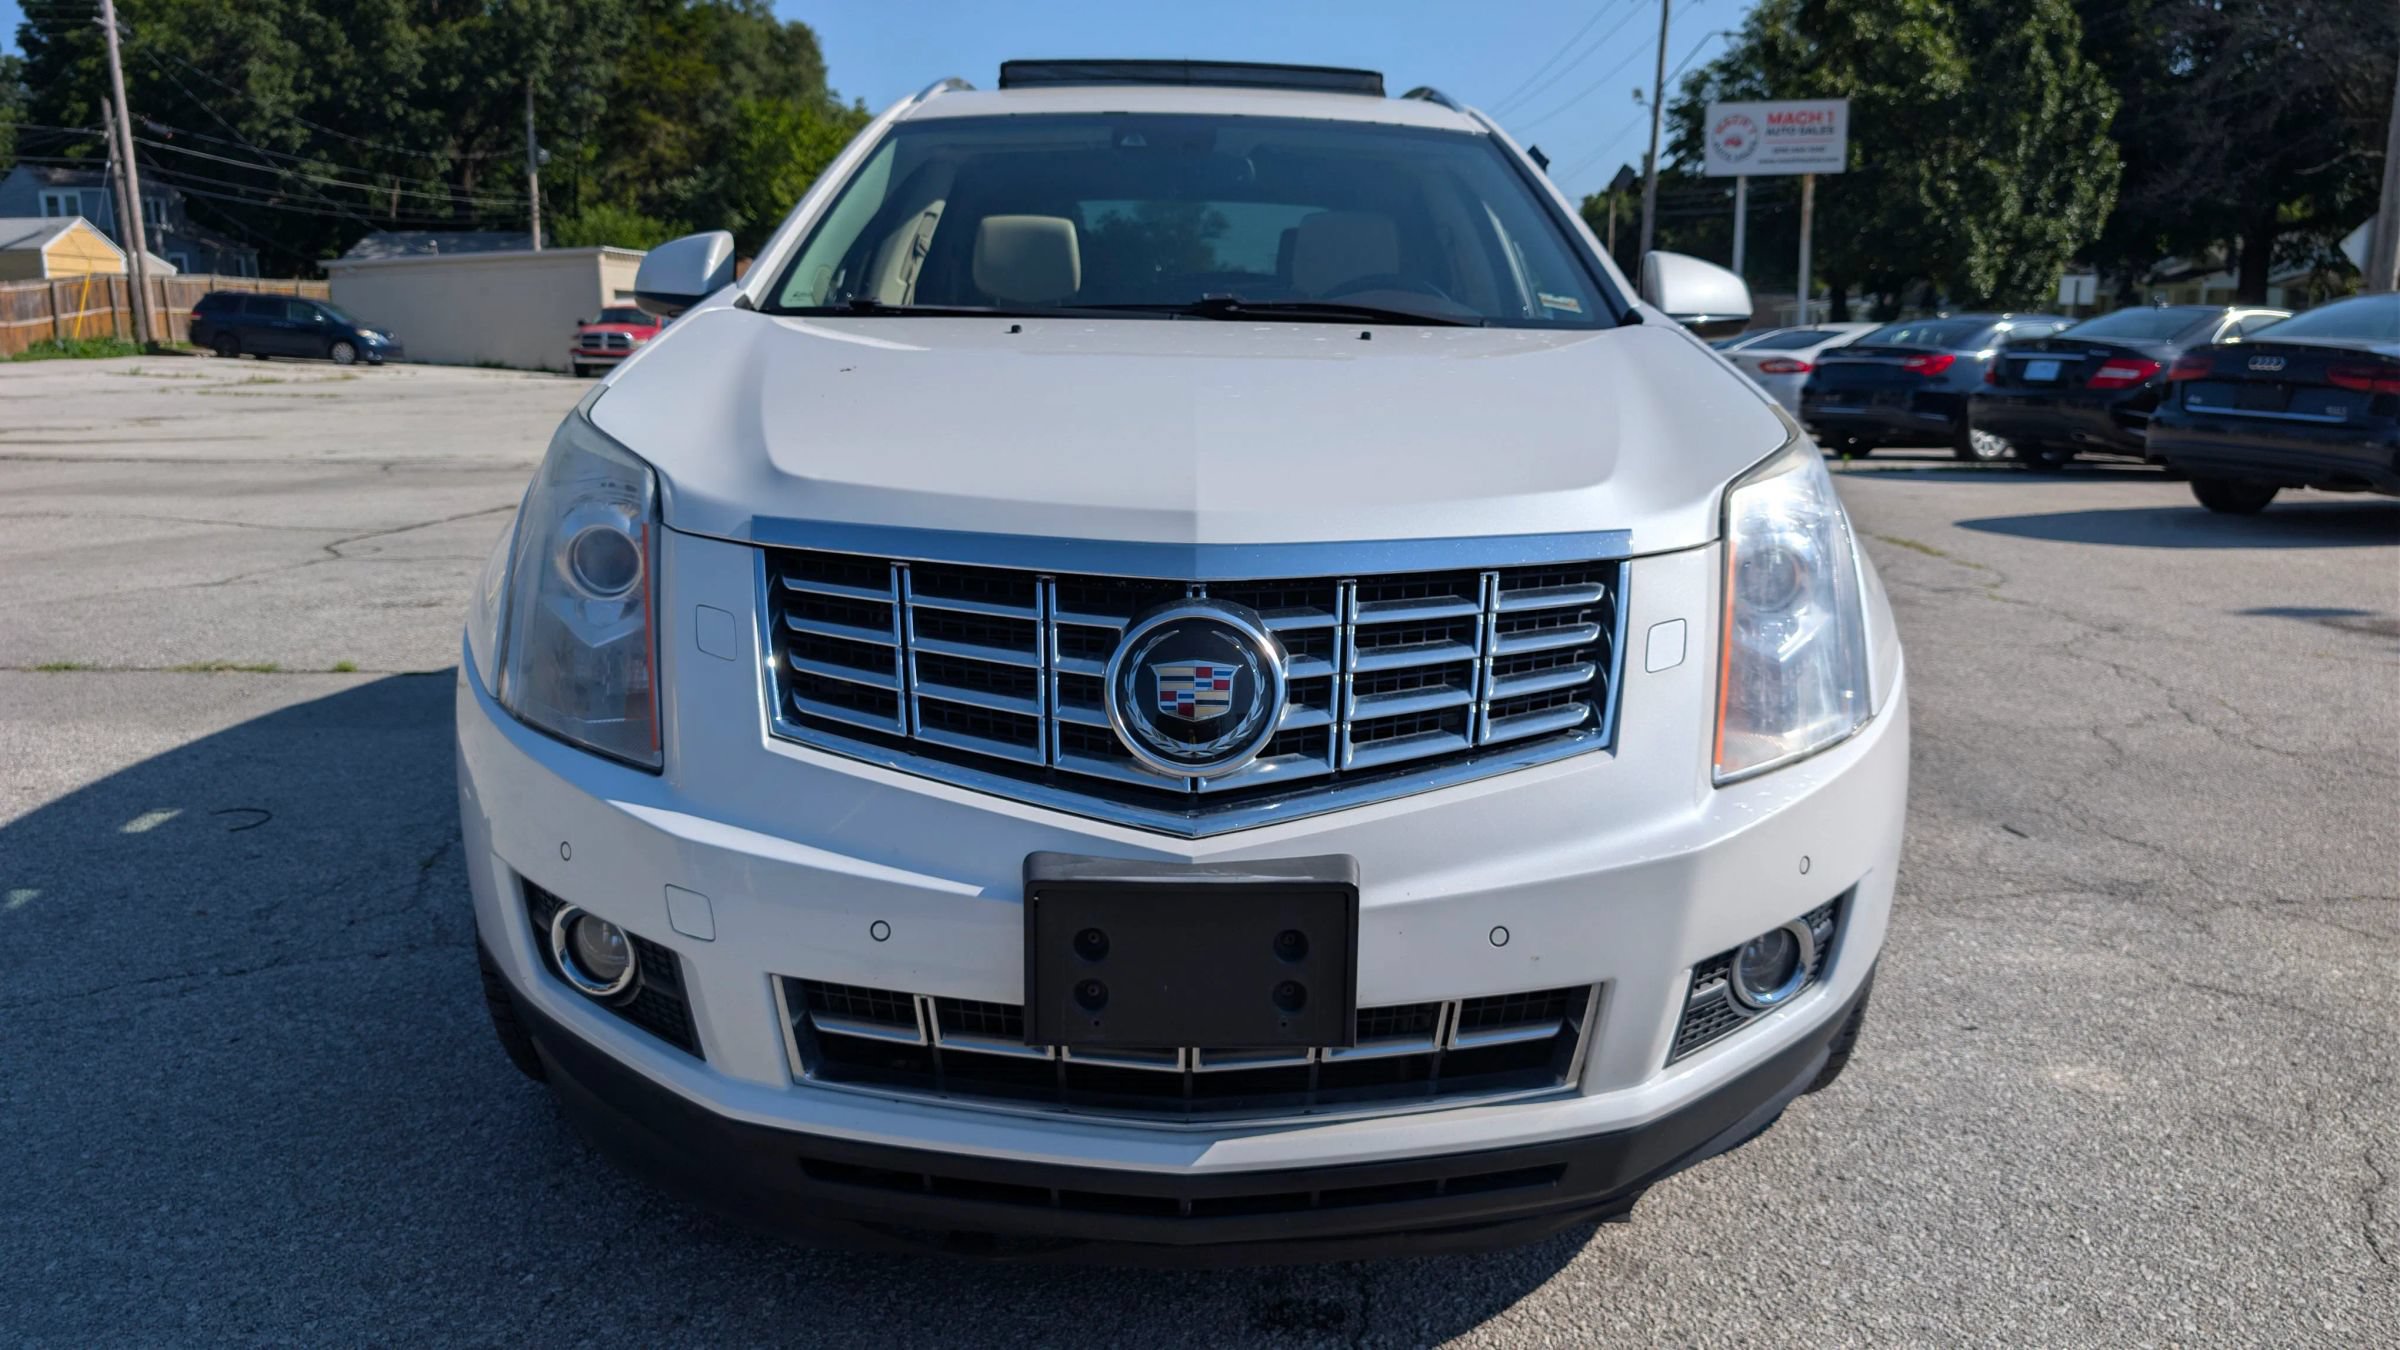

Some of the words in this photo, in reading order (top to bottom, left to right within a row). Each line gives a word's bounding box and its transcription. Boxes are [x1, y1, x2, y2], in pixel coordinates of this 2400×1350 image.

[1767, 111, 1824, 125] MACH
[1765, 126, 1796, 136] AUTO
[1799, 125, 1834, 136] SALES
